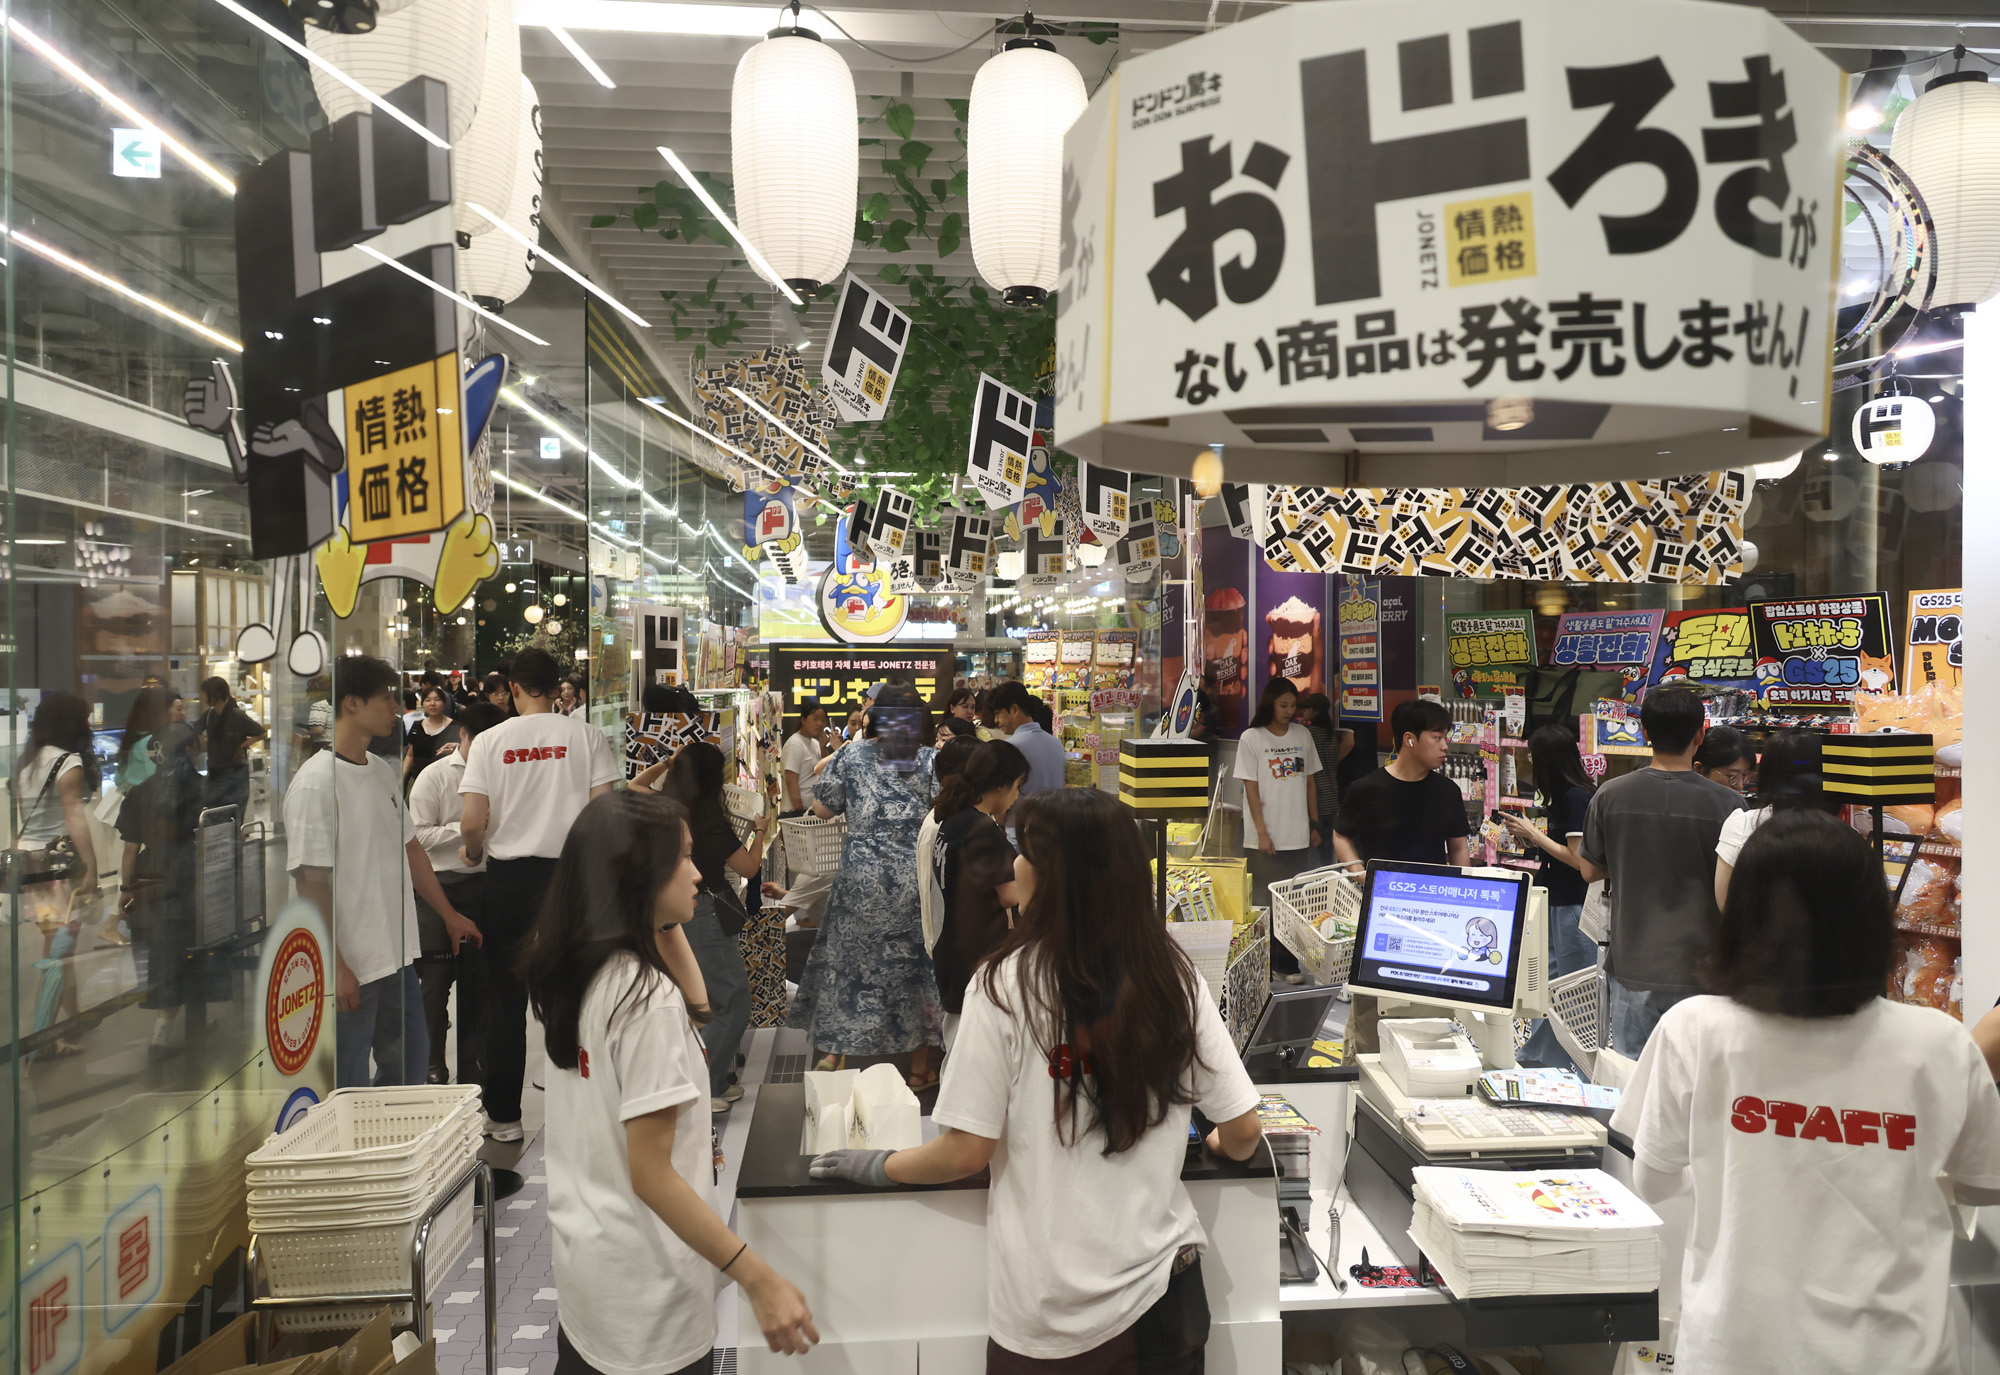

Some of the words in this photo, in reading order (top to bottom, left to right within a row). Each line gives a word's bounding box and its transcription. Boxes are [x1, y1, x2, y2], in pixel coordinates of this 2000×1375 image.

[1455, 203, 1525, 241] 情熱
[1416, 211, 1438, 291] JONETZ
[1457, 240, 1527, 278] 価格
[828, 280, 907, 379] ド
[854, 358, 866, 389] JONETZ
[354, 384, 427, 456] 情熱
[972, 380, 1033, 471] ド
[1860, 403, 1903, 450] ド
[996, 449, 1005, 477] JONETZ
[358, 456, 430, 523] 価格
[871, 490, 913, 541] ド
[949, 515, 991, 569] ド
[1765, 602, 1817, 618] 팝업스토어
[1819, 600, 1864, 616] 한정상품
[1919, 594, 1952, 606] GS25
[1910, 614, 1962, 644] MO
[793, 660, 833, 670] 돈키호테의
[835, 660, 850, 670] 자체
[852, 660, 876, 670] 브랜드
[877, 661, 912, 670] JONETZ
[913, 660, 936, 670] 전문점
[1219, 659, 1234, 670] OAK
[1284, 656, 1299, 667] OAK
[1450, 630, 1530, 667] 생활잡화
[1555, 631, 1652, 666] 생활잡화
[1216, 664, 1238, 681] BERRY
[1281, 663, 1302, 679] BERRY
[1783, 655, 1860, 686] GS25
[1092, 690, 1114, 709] 최고
[1116, 691, 1141, 707] 대박
[503, 746, 567, 764] STAFF
[1389, 881, 1416, 893] GS25
[1418, 883, 1478, 900] 스토어매니저
[1480, 889, 1501, 902] 톡톡
[278, 980, 316, 1020] JONETZ
[1731, 1095, 1917, 1151] STAFF
